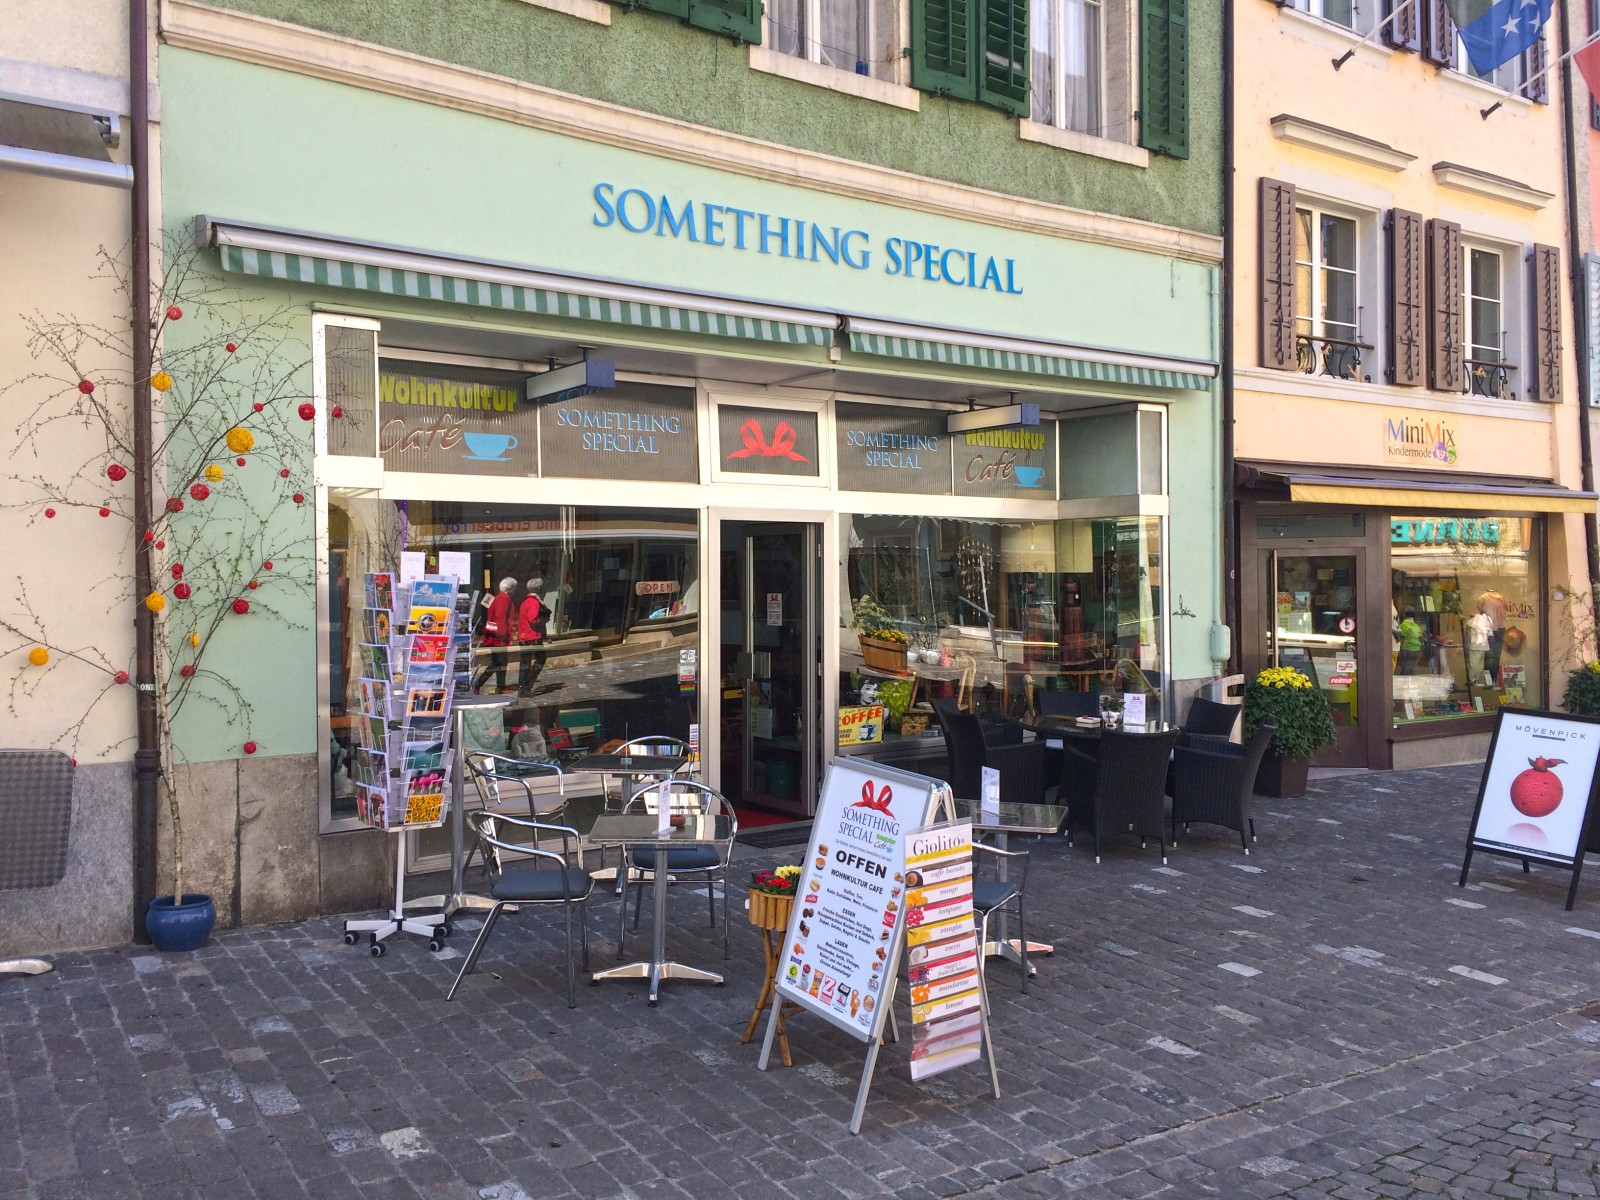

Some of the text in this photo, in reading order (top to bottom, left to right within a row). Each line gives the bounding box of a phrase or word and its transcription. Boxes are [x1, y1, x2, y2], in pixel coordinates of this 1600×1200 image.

[592, 182, 1024, 296] SOMETHING SPECIAL
[557, 408, 680, 434] SOMETHING
[1388, 416, 1456, 447] MiniMix
[582, 432, 660, 455] SPECIAL
[846, 430, 939, 453] SOMETHING
[1388, 445, 1432, 459] Kindermode
[865, 450, 923, 470] SPECIAL
[964, 451, 1017, 485] Café
[644, 583, 674, 593] OPEN
[1330, 677, 1352, 685] reima
[1515, 725, 1587, 740] MÖVENPICK
[838, 821, 874, 843] SPECIAL
[841, 806, 900, 836] SOMETHING
[913, 831, 960, 856] Giolito
[834, 849, 887, 878] OFFEN
[830, 868, 868, 888] WOHNKULTUR
[842, 907, 856, 917] ESSEN
[834, 938, 848, 949] LADEN
